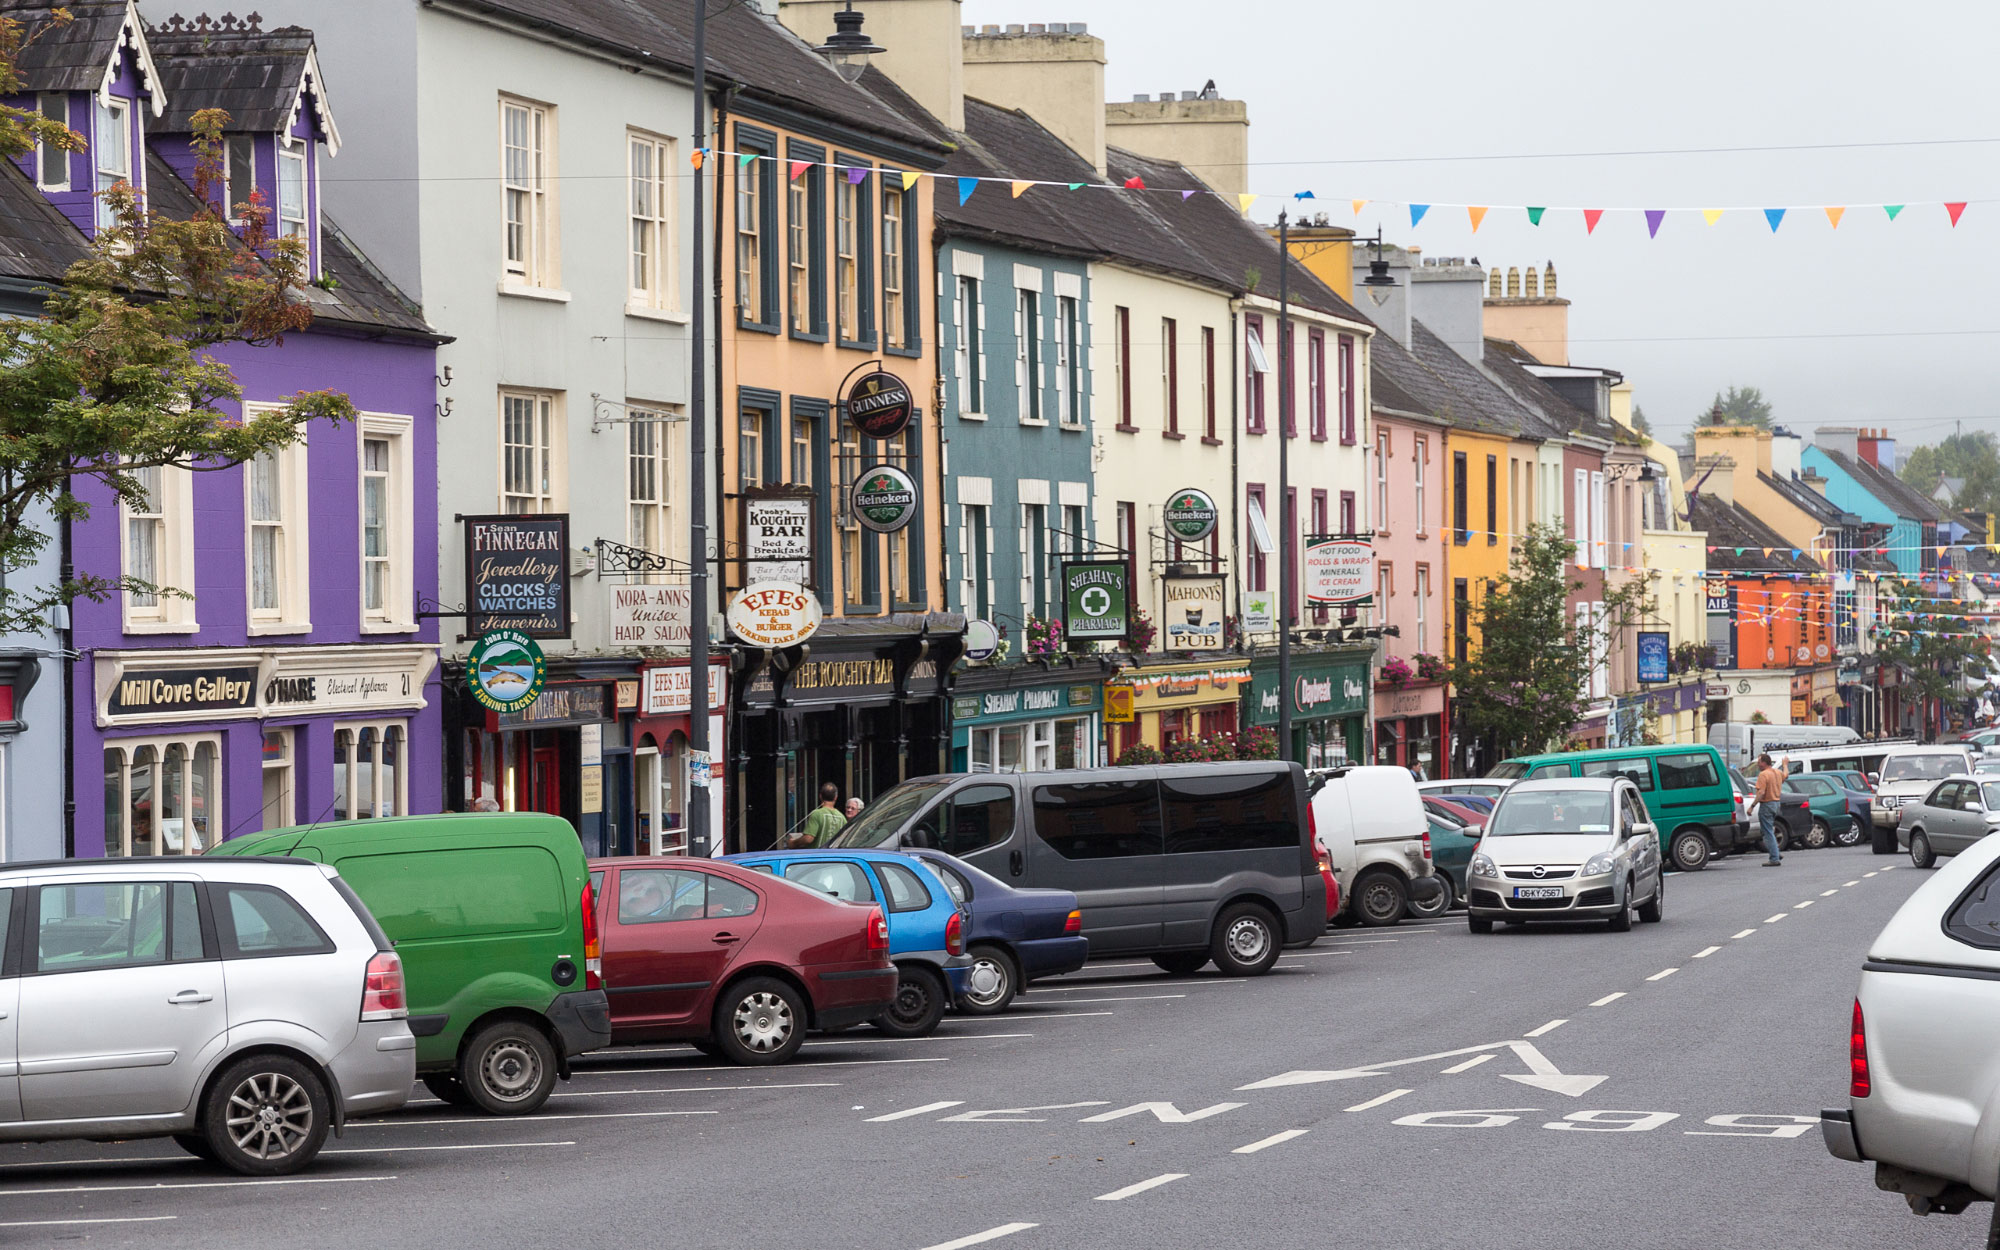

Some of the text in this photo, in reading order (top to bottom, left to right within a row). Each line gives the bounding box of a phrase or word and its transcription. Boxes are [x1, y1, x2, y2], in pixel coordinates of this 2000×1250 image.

[851, 390, 905, 414] GUINNESS
[857, 494, 910, 505] Heineken
[1168, 511, 1212, 520] Heineken
[490, 524, 517, 532] Sean
[761, 526, 805, 537] BAR
[474, 525, 559, 551] FINNEGAN
[1319, 547, 1336, 555] HOT
[1308, 558, 1331, 566] ROLLS
[1342, 557, 1370, 565] WRAPS
[476, 557, 559, 584] Jewellery
[777, 565, 799, 574] Food
[1320, 568, 1360, 576] MINERALS
[1070, 569, 1122, 591] SHEAHAN'S
[1319, 578, 1361, 586] ICE CREAM
[480, 583, 561, 597] CLOCKS &
[1167, 582, 1221, 602] MAHONY'S
[1326, 588, 1354, 596] COFFEE
[479, 597, 556, 610] WATCHES
[739, 590, 808, 612] EFES
[1708, 599, 1728, 609] AIB
[481, 612, 557, 629] Souvenirs
[632, 608, 679, 621] Unisex
[1073, 617, 1120, 631] PHARMACY
[484, 631, 529, 646] John O' Hare
[616, 626, 692, 640] HAIR SALON
[735, 621, 815, 644] TURKISH TAKE AWAY
[1173, 635, 1216, 647] PUB
[796, 662, 818, 688] THE
[820, 660, 871, 687] ROUGHTY
[874, 658, 894, 685] BAR
[265, 673, 410, 704] O'HARE Electrical Appliances 21
[655, 673, 673, 691] EFES
[675, 672, 692, 690] TAK
[120, 677, 251, 705] Mill Cove Gallery
[1301, 677, 1331, 708] Daybreak
[475, 688, 539, 712] FISHING TACKLE
[653, 695, 675, 707] TURKISH
[1023, 690, 1059, 710] PHARMACY
[1520, 888, 1560, 898] 06-KY-2567
